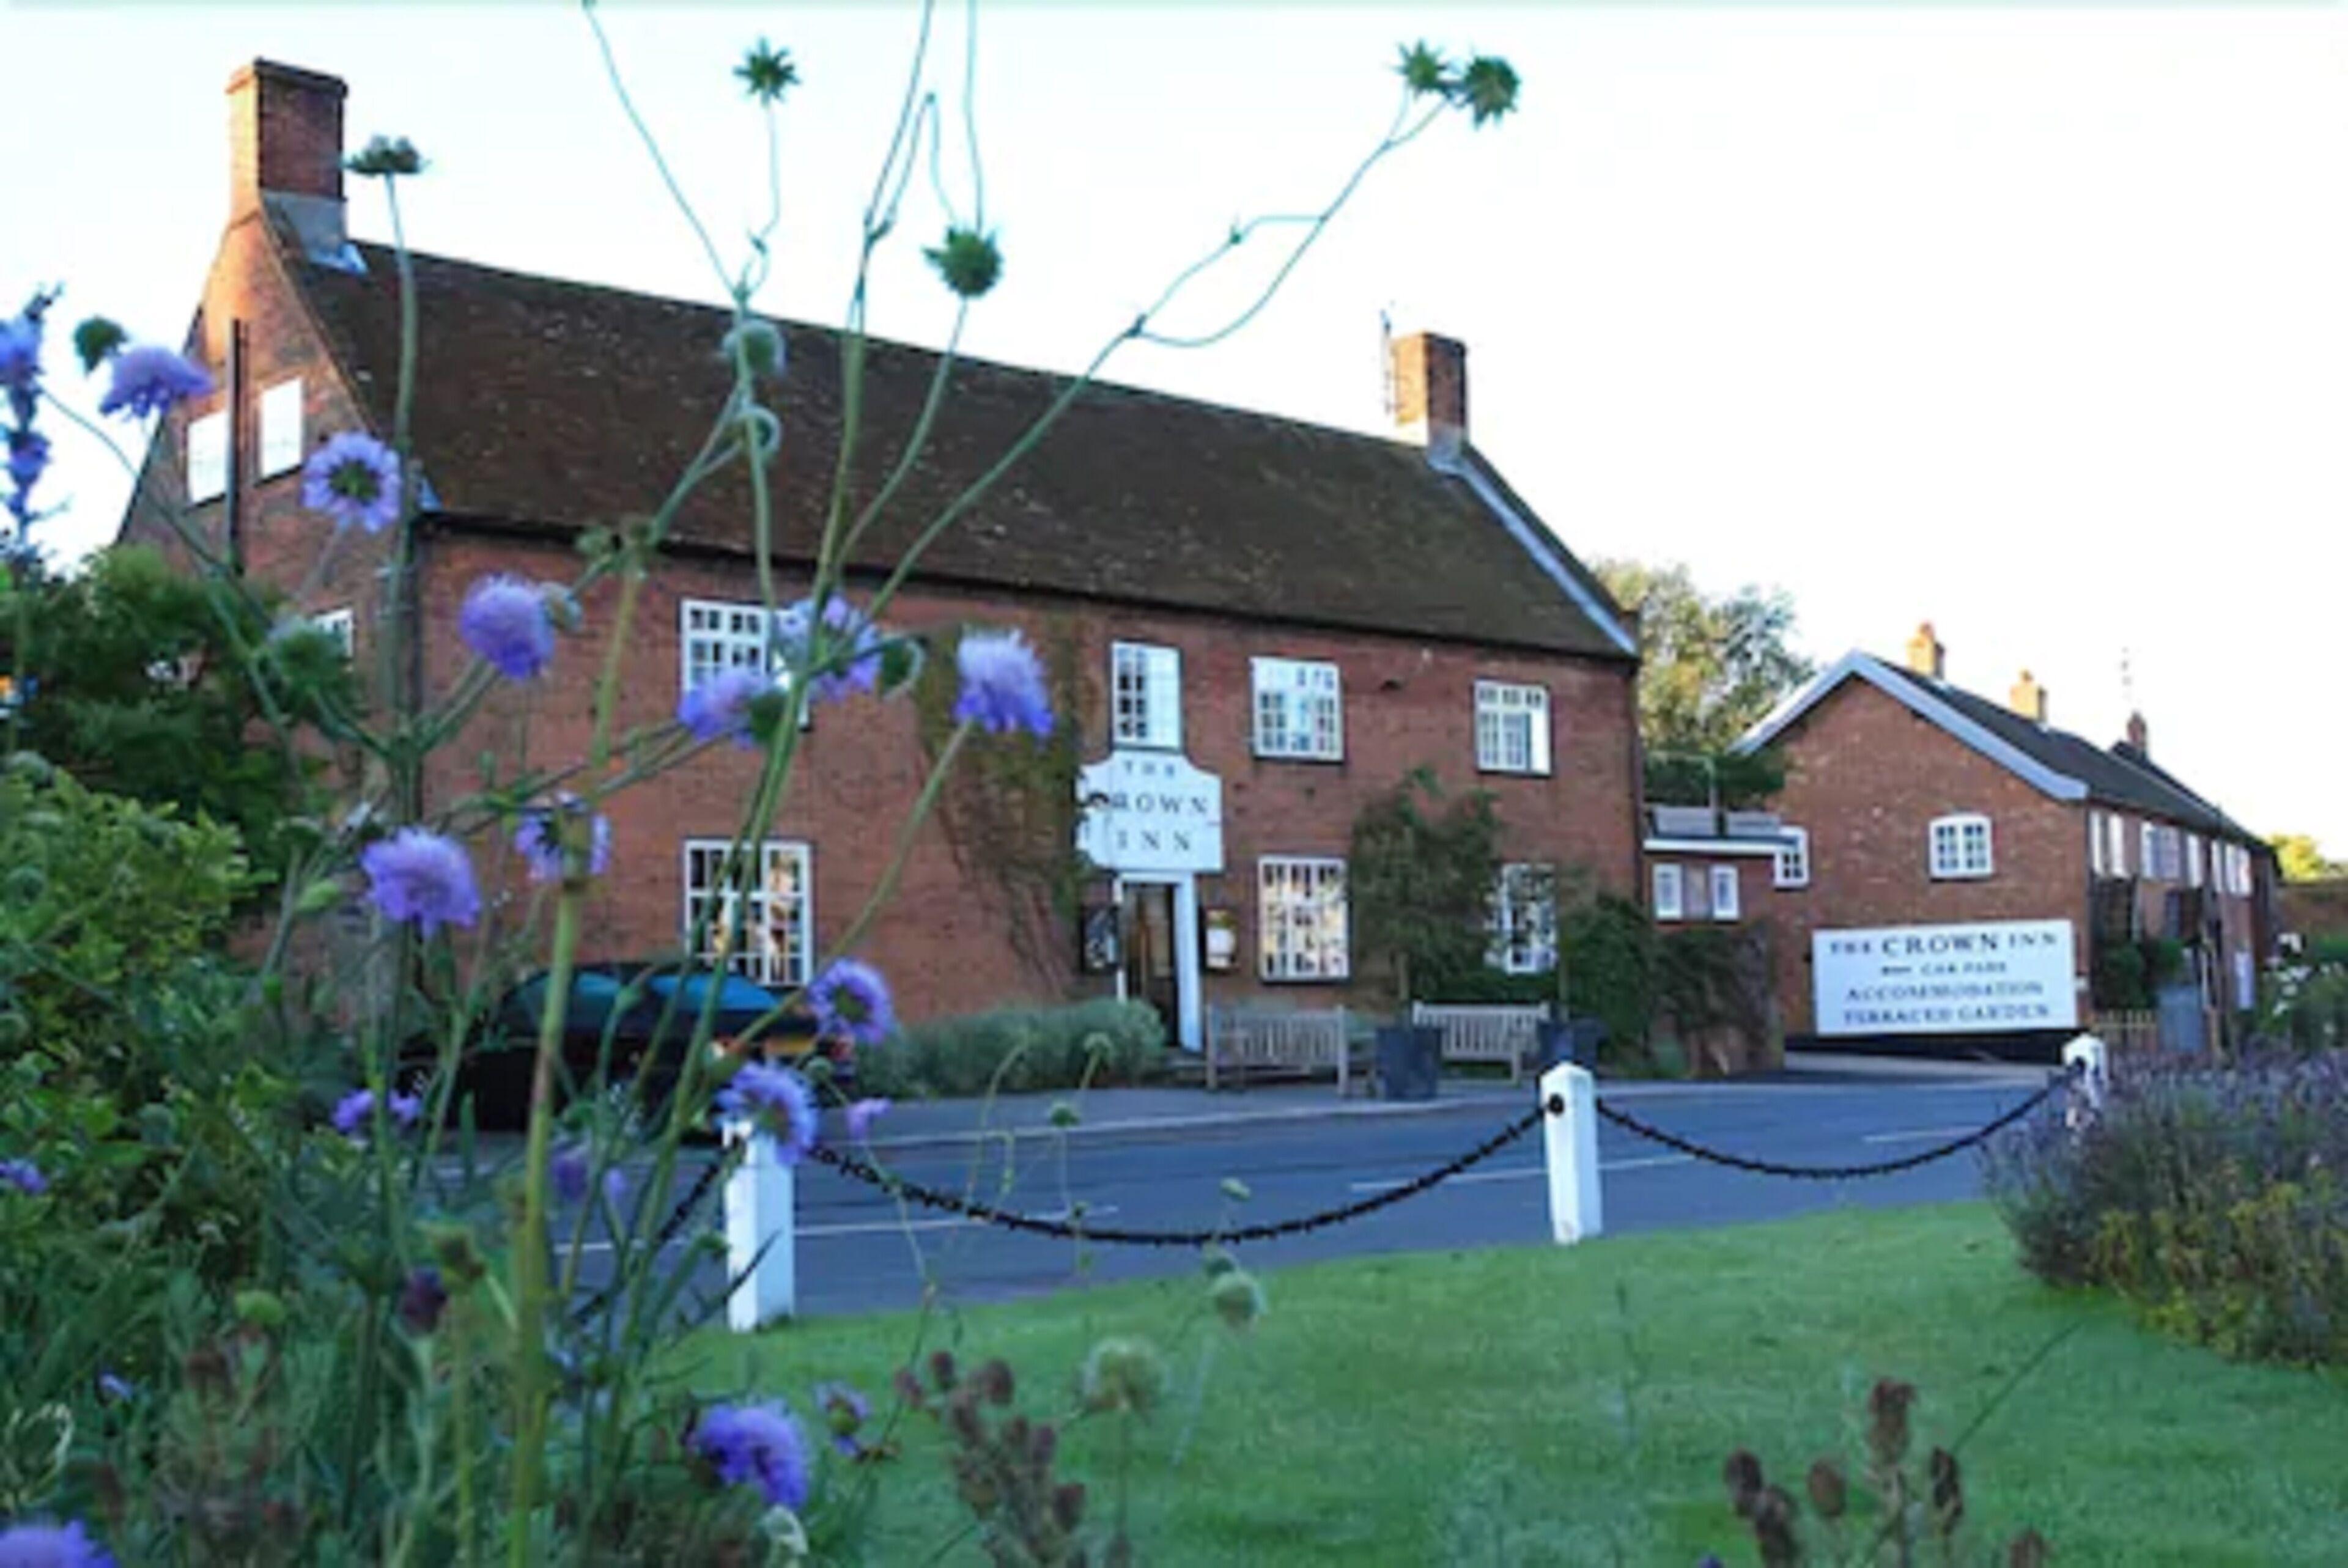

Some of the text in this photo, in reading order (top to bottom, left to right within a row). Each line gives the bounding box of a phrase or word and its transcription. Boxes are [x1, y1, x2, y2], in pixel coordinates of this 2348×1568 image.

[1123, 760, 1176, 779] THE
[1117, 829, 1191, 852] INN
[1829, 932, 2058, 956] THE CROWN INN
[1920, 961, 2007, 977] CAR PARK
[1845, 981, 2044, 1002] ACCOMMODATION
[1842, 1004, 2050, 1025] TERRACED GARDEN
